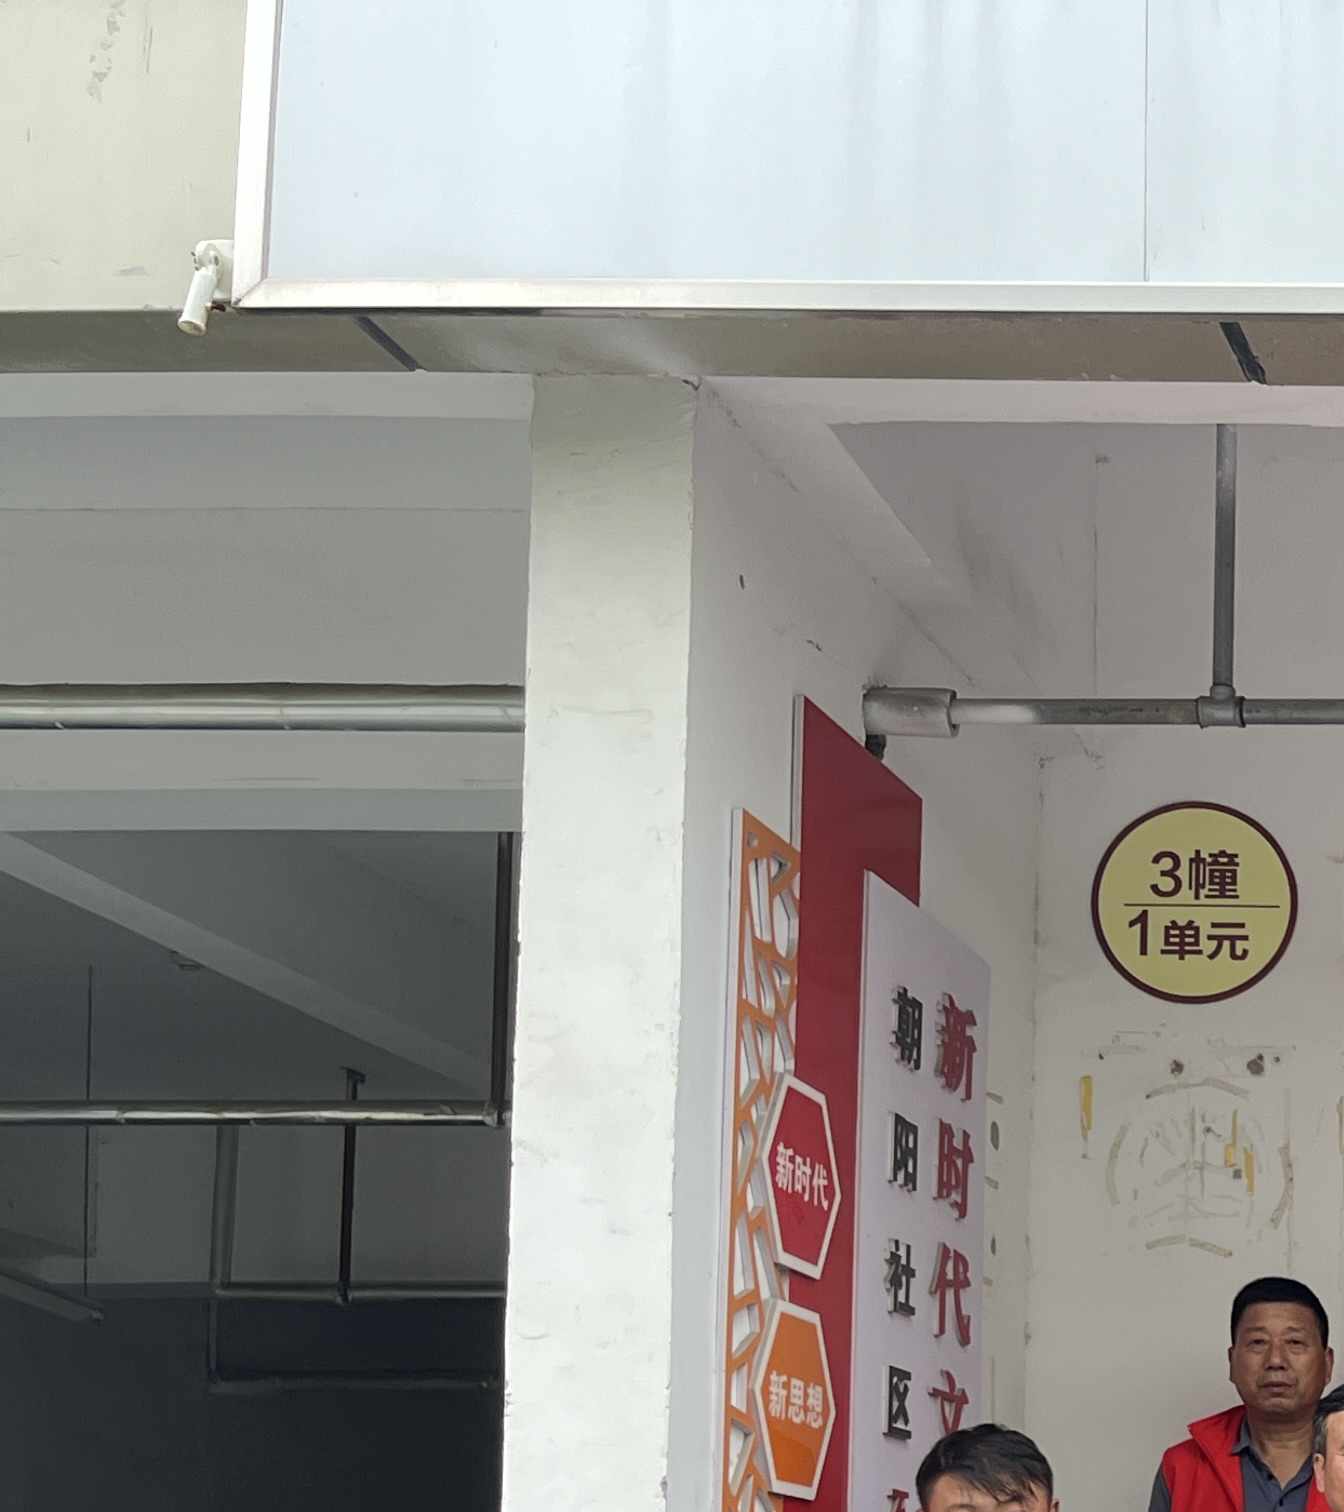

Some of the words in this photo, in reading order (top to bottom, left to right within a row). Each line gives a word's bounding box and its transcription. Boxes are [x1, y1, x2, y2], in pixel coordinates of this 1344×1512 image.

[1149, 849, 1241, 900] 3幢
[1128, 908, 1250, 961] 1单元
[775, 1142, 829, 1211] 新时代
[886, 985, 923, 1440] 朝阳社区
[768, 1370, 824, 1430] 新思想
